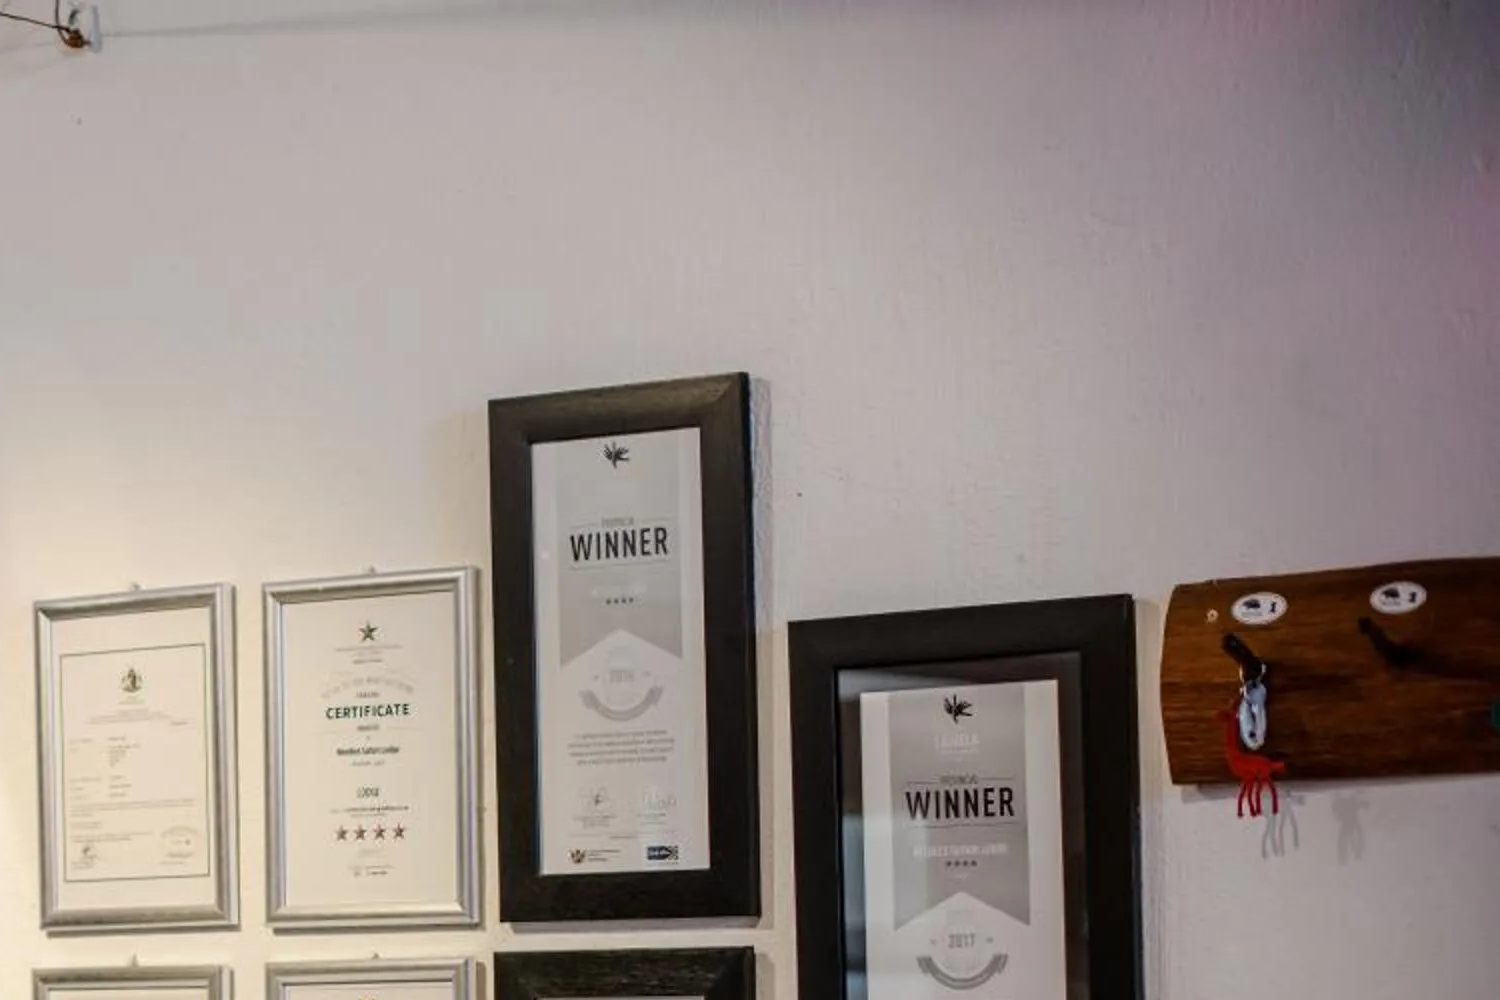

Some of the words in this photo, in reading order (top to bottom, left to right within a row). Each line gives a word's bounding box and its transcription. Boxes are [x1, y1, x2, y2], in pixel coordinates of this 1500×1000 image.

[569, 526, 669, 562] WINNER
[324, 702, 411, 720] CERTIFICATE
[905, 786, 1016, 821] WINNER
